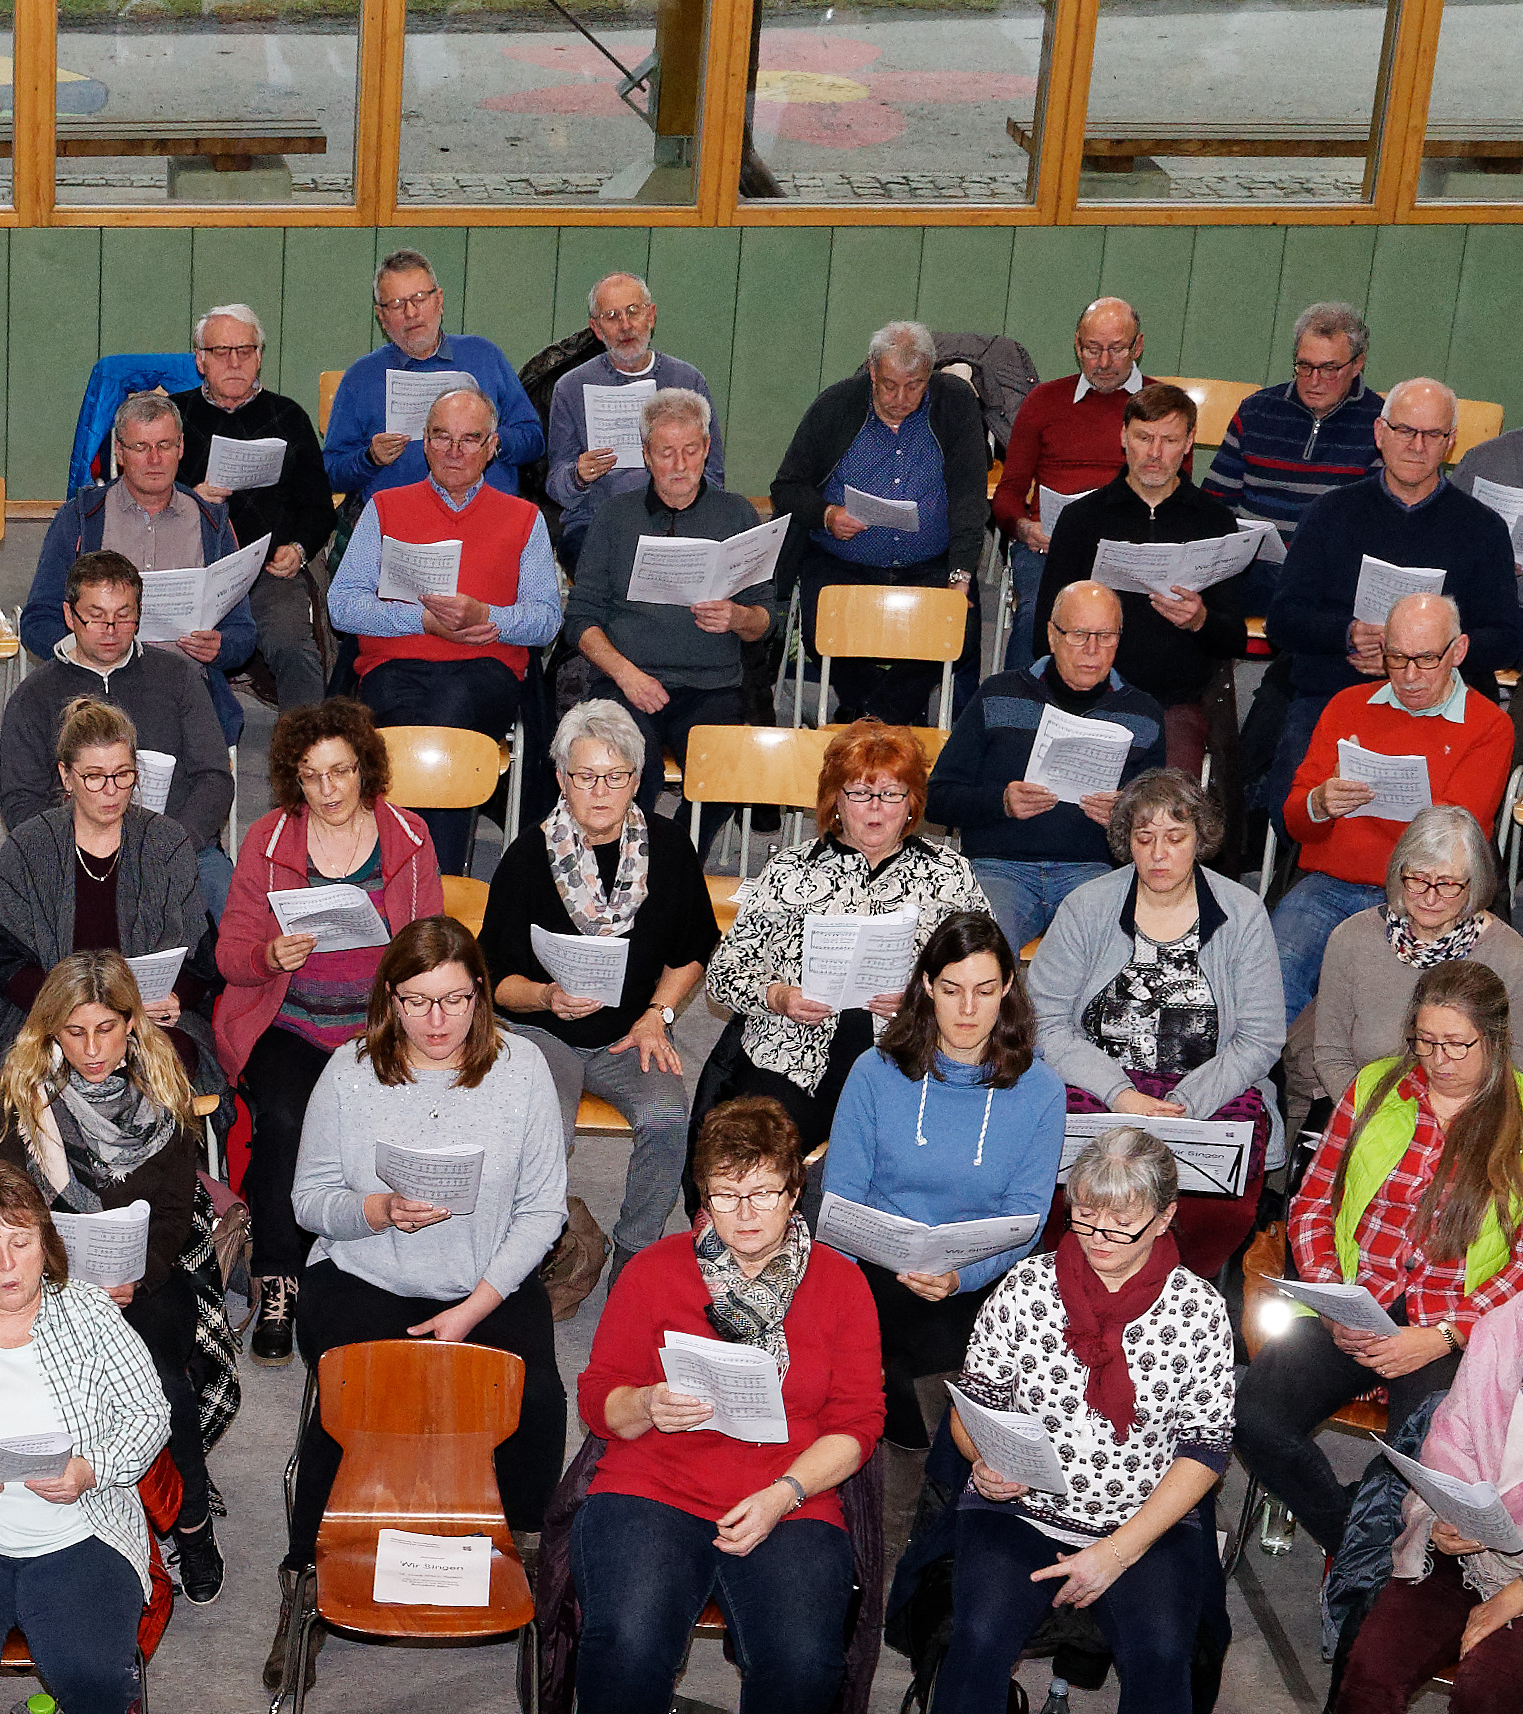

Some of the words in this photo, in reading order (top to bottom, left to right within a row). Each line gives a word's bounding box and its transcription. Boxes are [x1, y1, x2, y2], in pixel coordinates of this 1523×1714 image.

[1187, 1150, 1225, 1160] Singen
[399, 1560, 421, 1570] Wir
[422, 1562, 465, 1572] Singen
